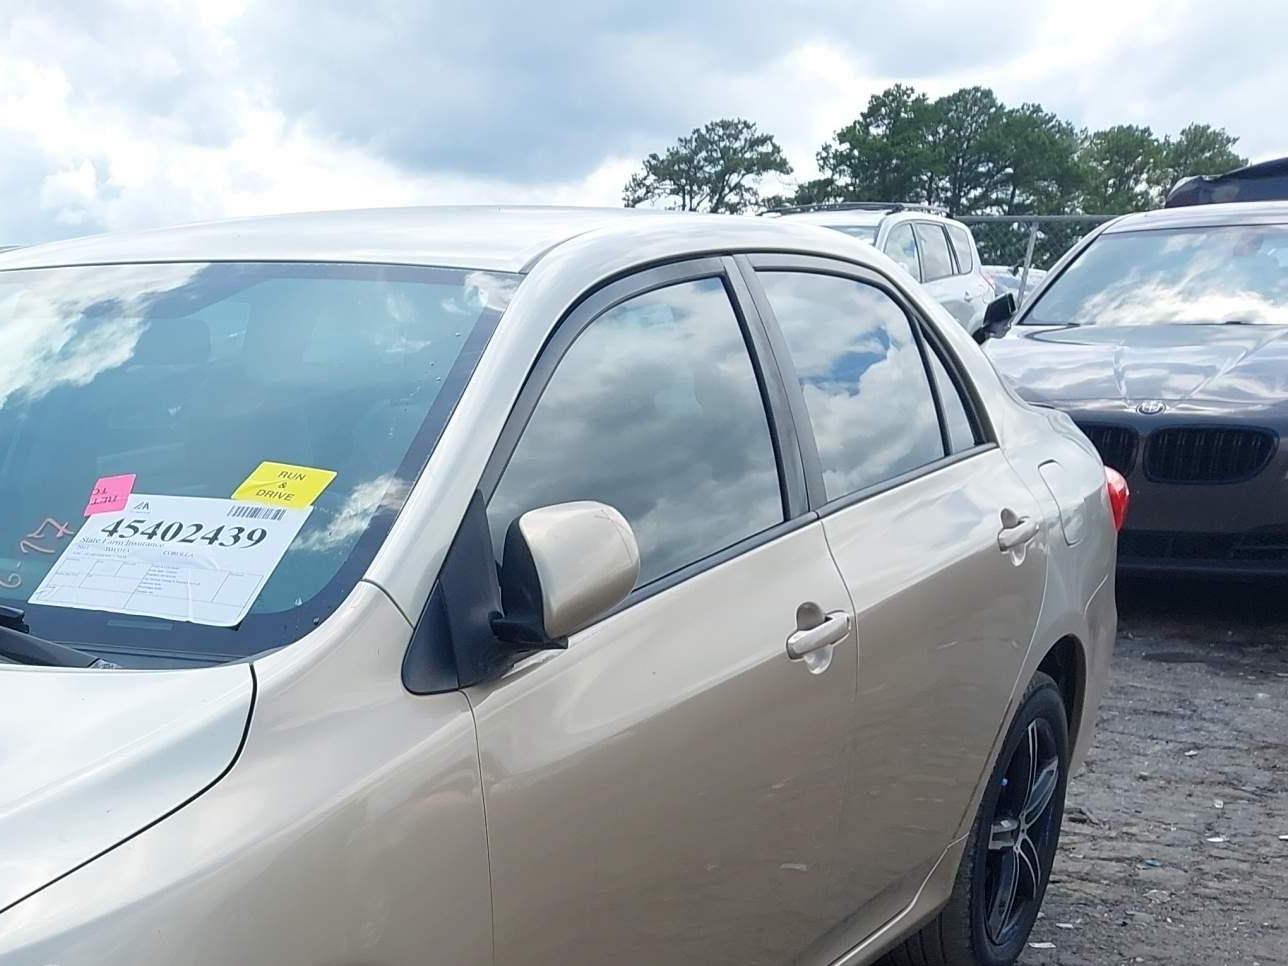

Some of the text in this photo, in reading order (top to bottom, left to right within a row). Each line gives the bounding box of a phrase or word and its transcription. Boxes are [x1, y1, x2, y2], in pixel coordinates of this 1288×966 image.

[278, 470, 307, 481] RUN
[278, 481, 287, 489] &
[255, 489, 296, 501] DRIVE
[100, 517, 268, 549] 45402439
[79, 536, 165, 548] State Farm Insurance
